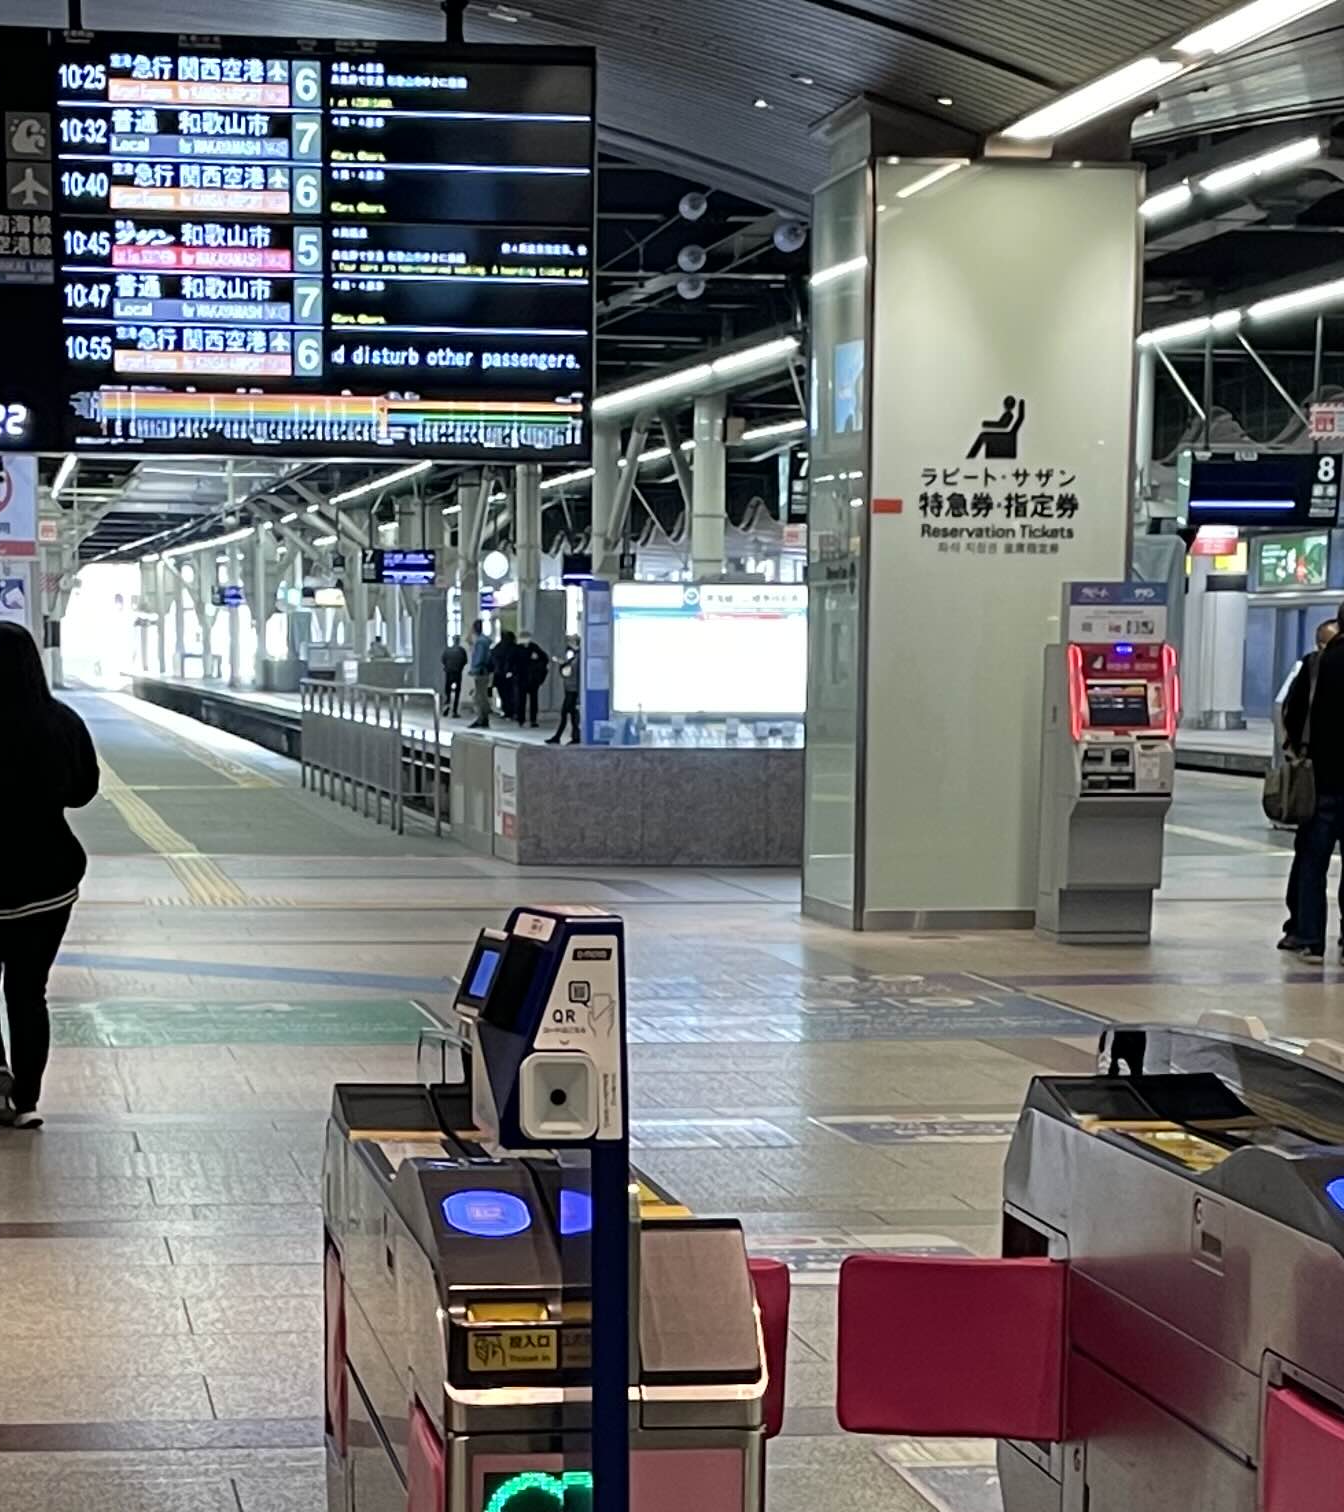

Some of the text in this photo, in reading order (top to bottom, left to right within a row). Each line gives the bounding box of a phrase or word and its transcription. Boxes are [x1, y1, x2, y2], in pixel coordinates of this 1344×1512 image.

[58, 64, 106, 90] 10:25
[295, 68, 318, 101] 6
[60, 118, 108, 144] 10:32
[112, 109, 158, 133] 普通
[179, 111, 270, 136] 和歌山市
[296, 122, 318, 154] 7
[112, 137, 150, 153] Local
[61, 171, 109, 197] 10:40
[295, 175, 318, 207] 6
[64, 231, 111, 256] 10:45
[181, 222, 271, 248] 和歌山市
[297, 234, 319, 266] 5
[64, 283, 111, 308] 10:47
[116, 275, 161, 298] 普通
[182, 276, 271, 301] 和歌山市
[298, 286, 320, 317] 7
[116, 301, 152, 317] Local
[65, 336, 112, 361] 10:55
[298, 338, 320, 370] 6
[352, 346, 419, 366] disturb
[426, 347, 474, 367] other
[482, 352, 581, 371] passengers.
[920, 468, 1077, 487] ラピート・サザン
[1318, 457, 1335, 482] 8
[919, 493, 1079, 518] 特急券・指定券
[921, 524, 1074, 539] Reservation Tickets
[553, 1009, 575, 1024] QR
